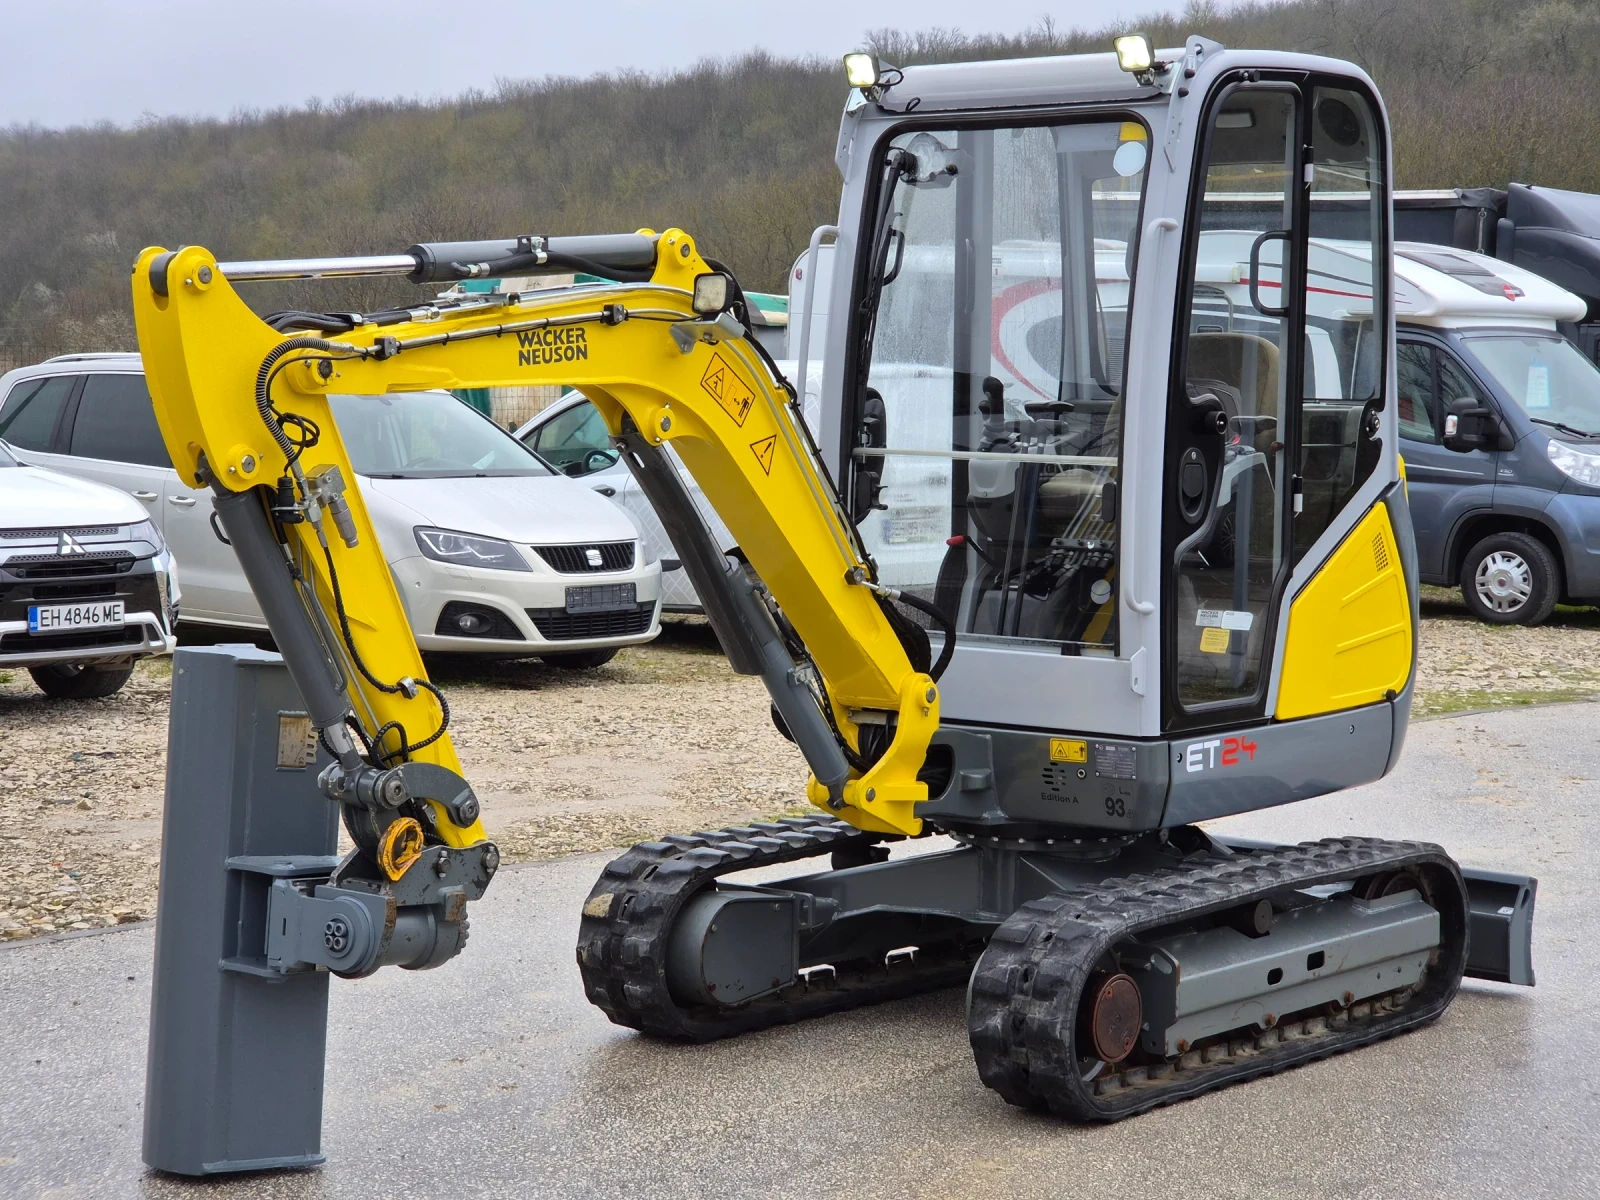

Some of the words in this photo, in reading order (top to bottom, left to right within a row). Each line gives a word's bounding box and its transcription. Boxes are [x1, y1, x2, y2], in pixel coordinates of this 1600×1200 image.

[515, 327, 587, 348] WACKER
[518, 344, 588, 366] NEUSON
[40, 609, 61, 627] EH
[63, 606, 100, 625] 4846
[103, 604, 122, 622] ME
[1186, 735, 1258, 772] ET24
[1041, 792, 1071, 804] Edition
[1072, 796, 1079, 804] A
[1105, 796, 1126, 818] 93
